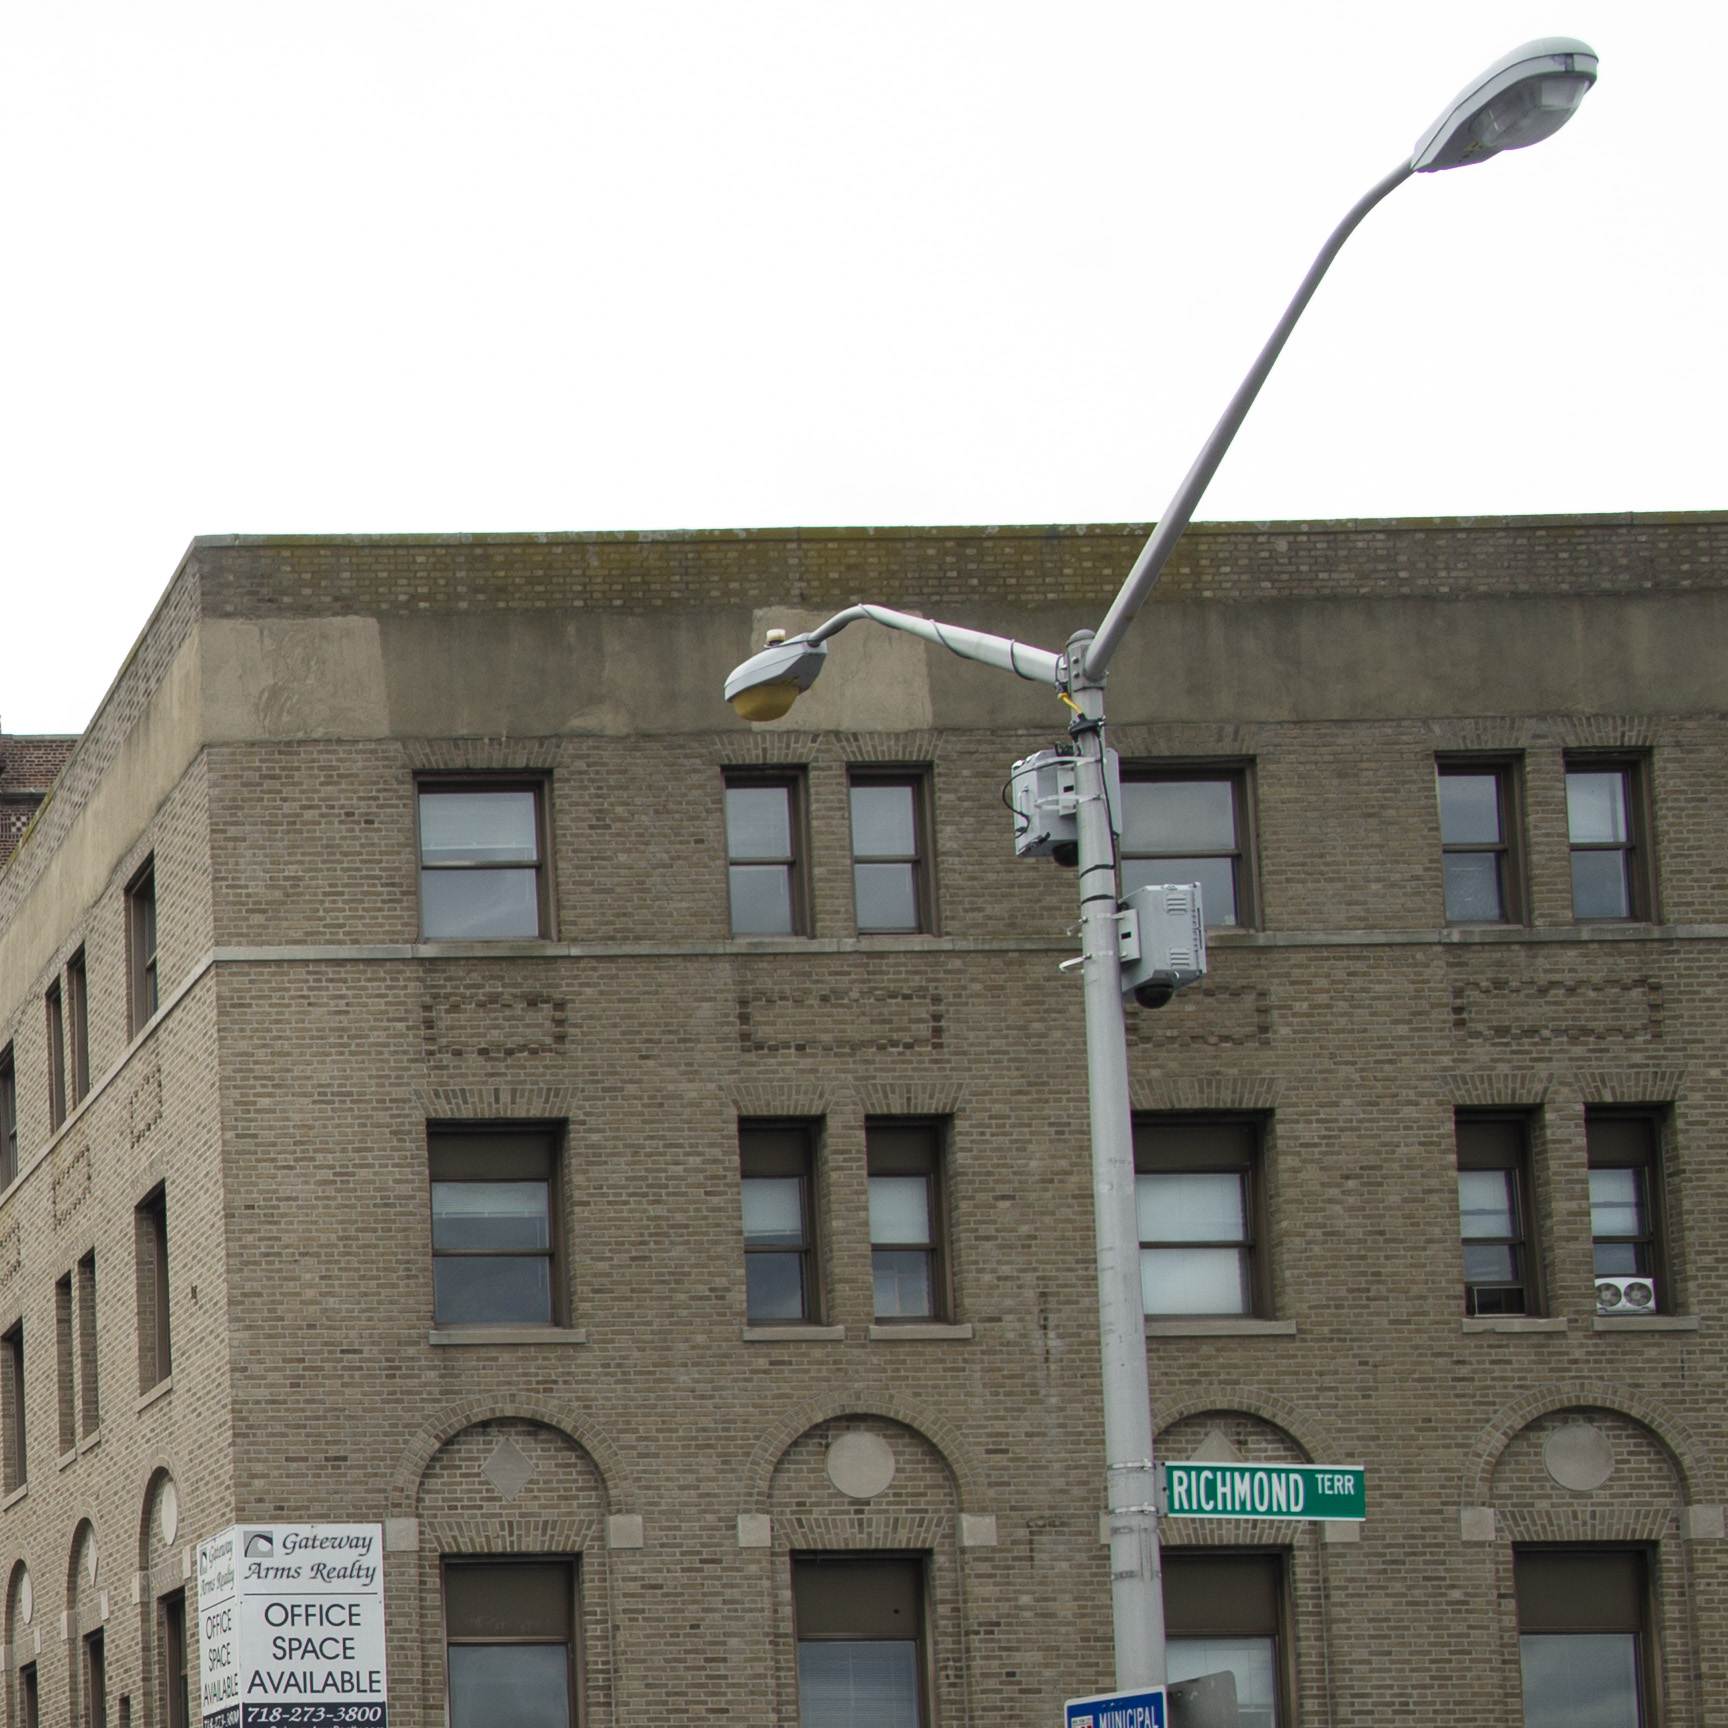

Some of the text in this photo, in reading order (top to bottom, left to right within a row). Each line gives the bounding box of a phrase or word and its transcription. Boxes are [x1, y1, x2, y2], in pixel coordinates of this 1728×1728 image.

[1173, 1471, 1354, 1512] RICHMOND TERR
[282, 1533, 373, 1556] Gateway
[244, 1560, 376, 1586] Arms Realty
[205, 1609, 231, 1639] OFFICE
[264, 1603, 361, 1627] OFFICE
[208, 1643, 230, 1672] SPACE
[272, 1636, 355, 1660] SPACE
[204, 1674, 238, 1707] AVAILABLE
[247, 1670, 381, 1694] AVAILABLE
[247, 1707, 381, 1722] 718-273-3800
